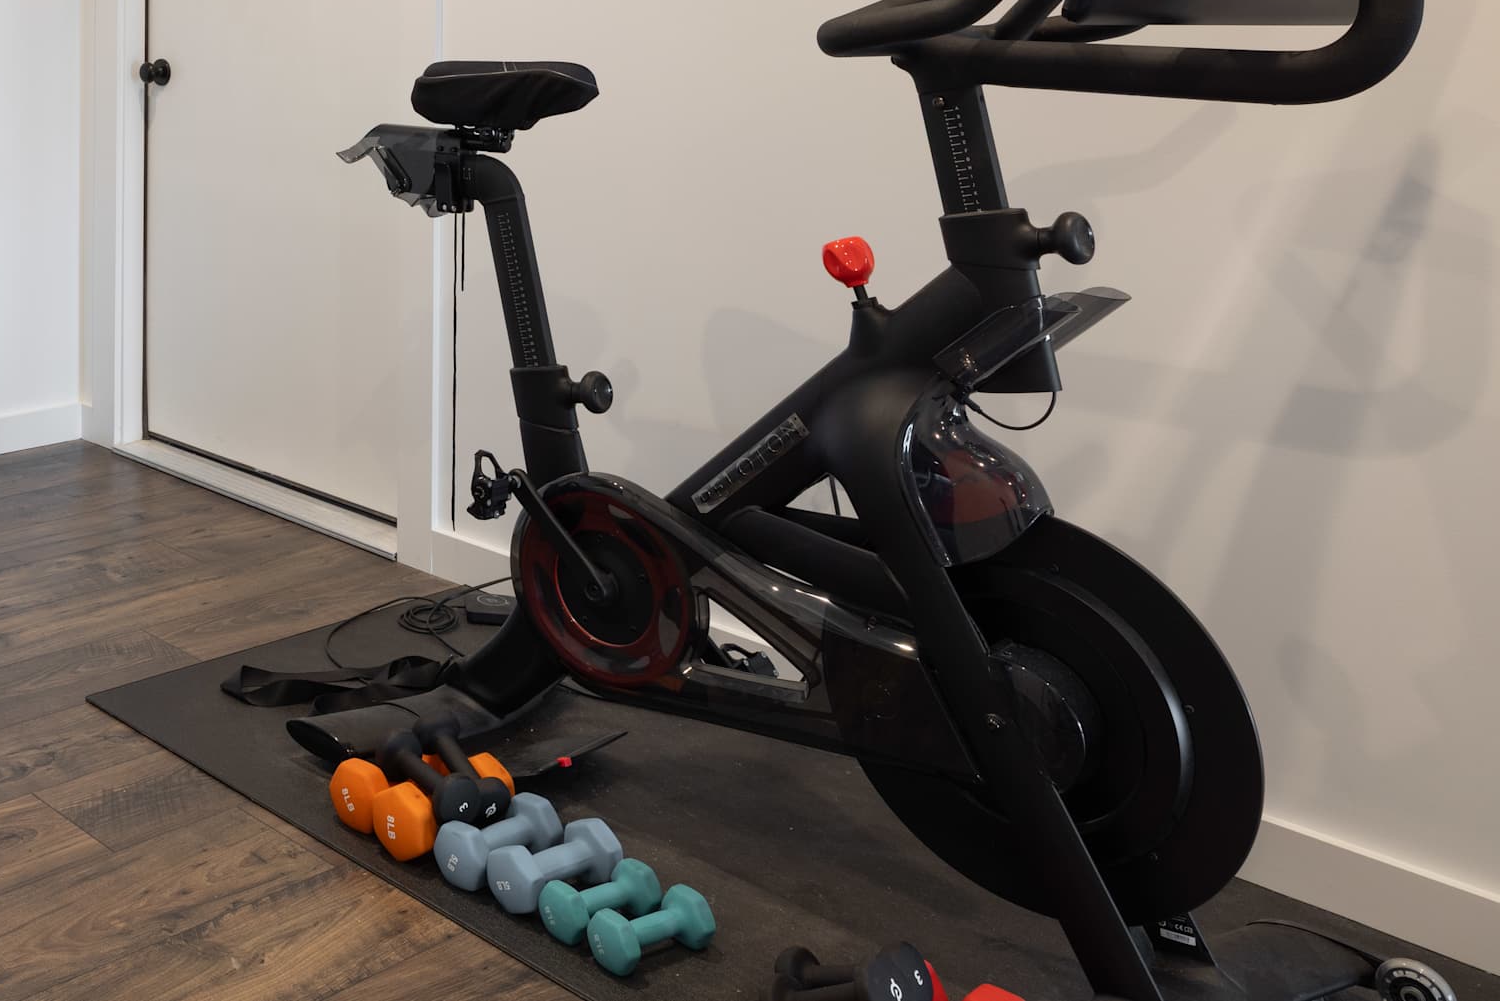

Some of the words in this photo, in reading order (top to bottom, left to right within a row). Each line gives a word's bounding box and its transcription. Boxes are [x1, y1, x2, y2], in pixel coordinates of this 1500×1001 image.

[341, 787, 356, 812] 8LB
[459, 802, 469, 813] 3
[386, 814, 396, 840] 8LB
[447, 854, 459, 872] 5LB
[914, 969, 924, 986] 3
